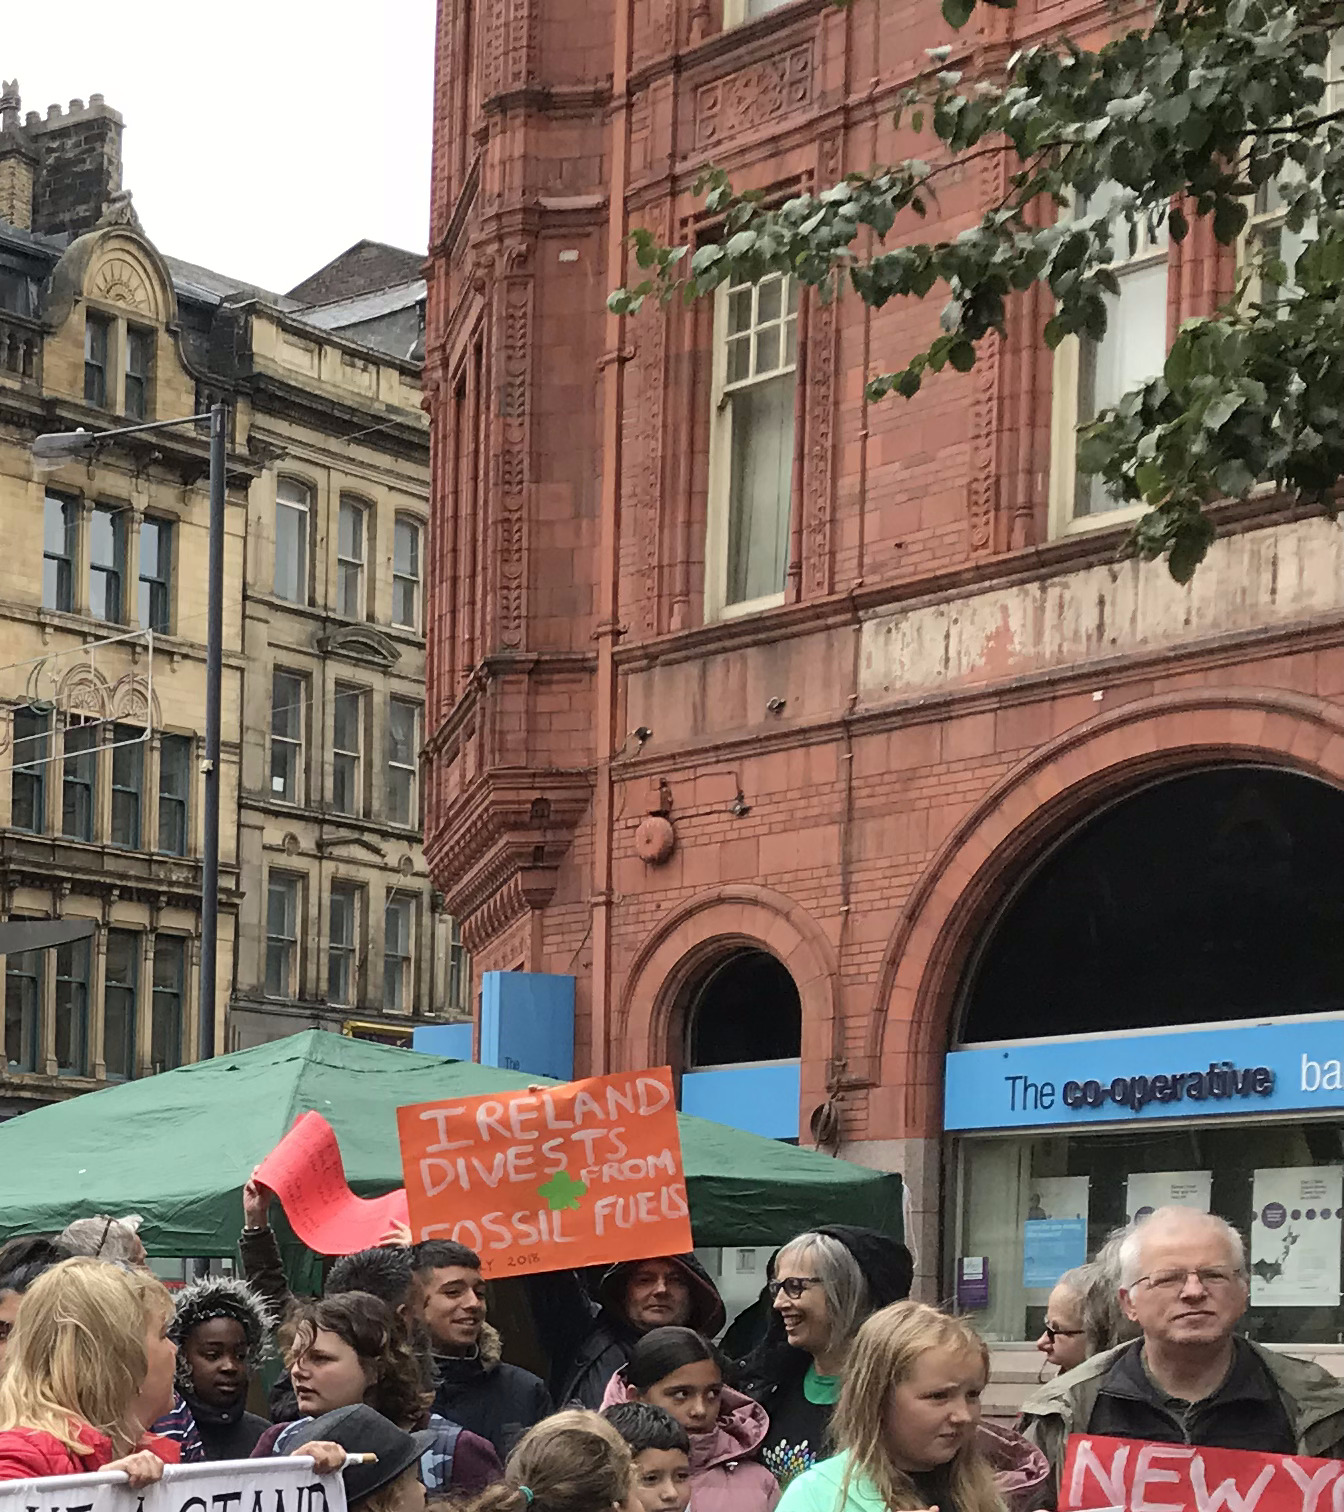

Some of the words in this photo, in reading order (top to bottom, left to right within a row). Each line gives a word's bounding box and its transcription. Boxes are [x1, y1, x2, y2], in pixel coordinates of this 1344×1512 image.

[1004, 1075, 1055, 1112] The
[1062, 1060, 1285, 1112] co-operative
[1301, 1053, 1344, 1091] ba
[419, 1077, 670, 1153] IRELAND
[419, 1127, 628, 1197] DIVESTS
[580, 1148, 676, 1188] FROM
[594, 1182, 689, 1236] FUELS
